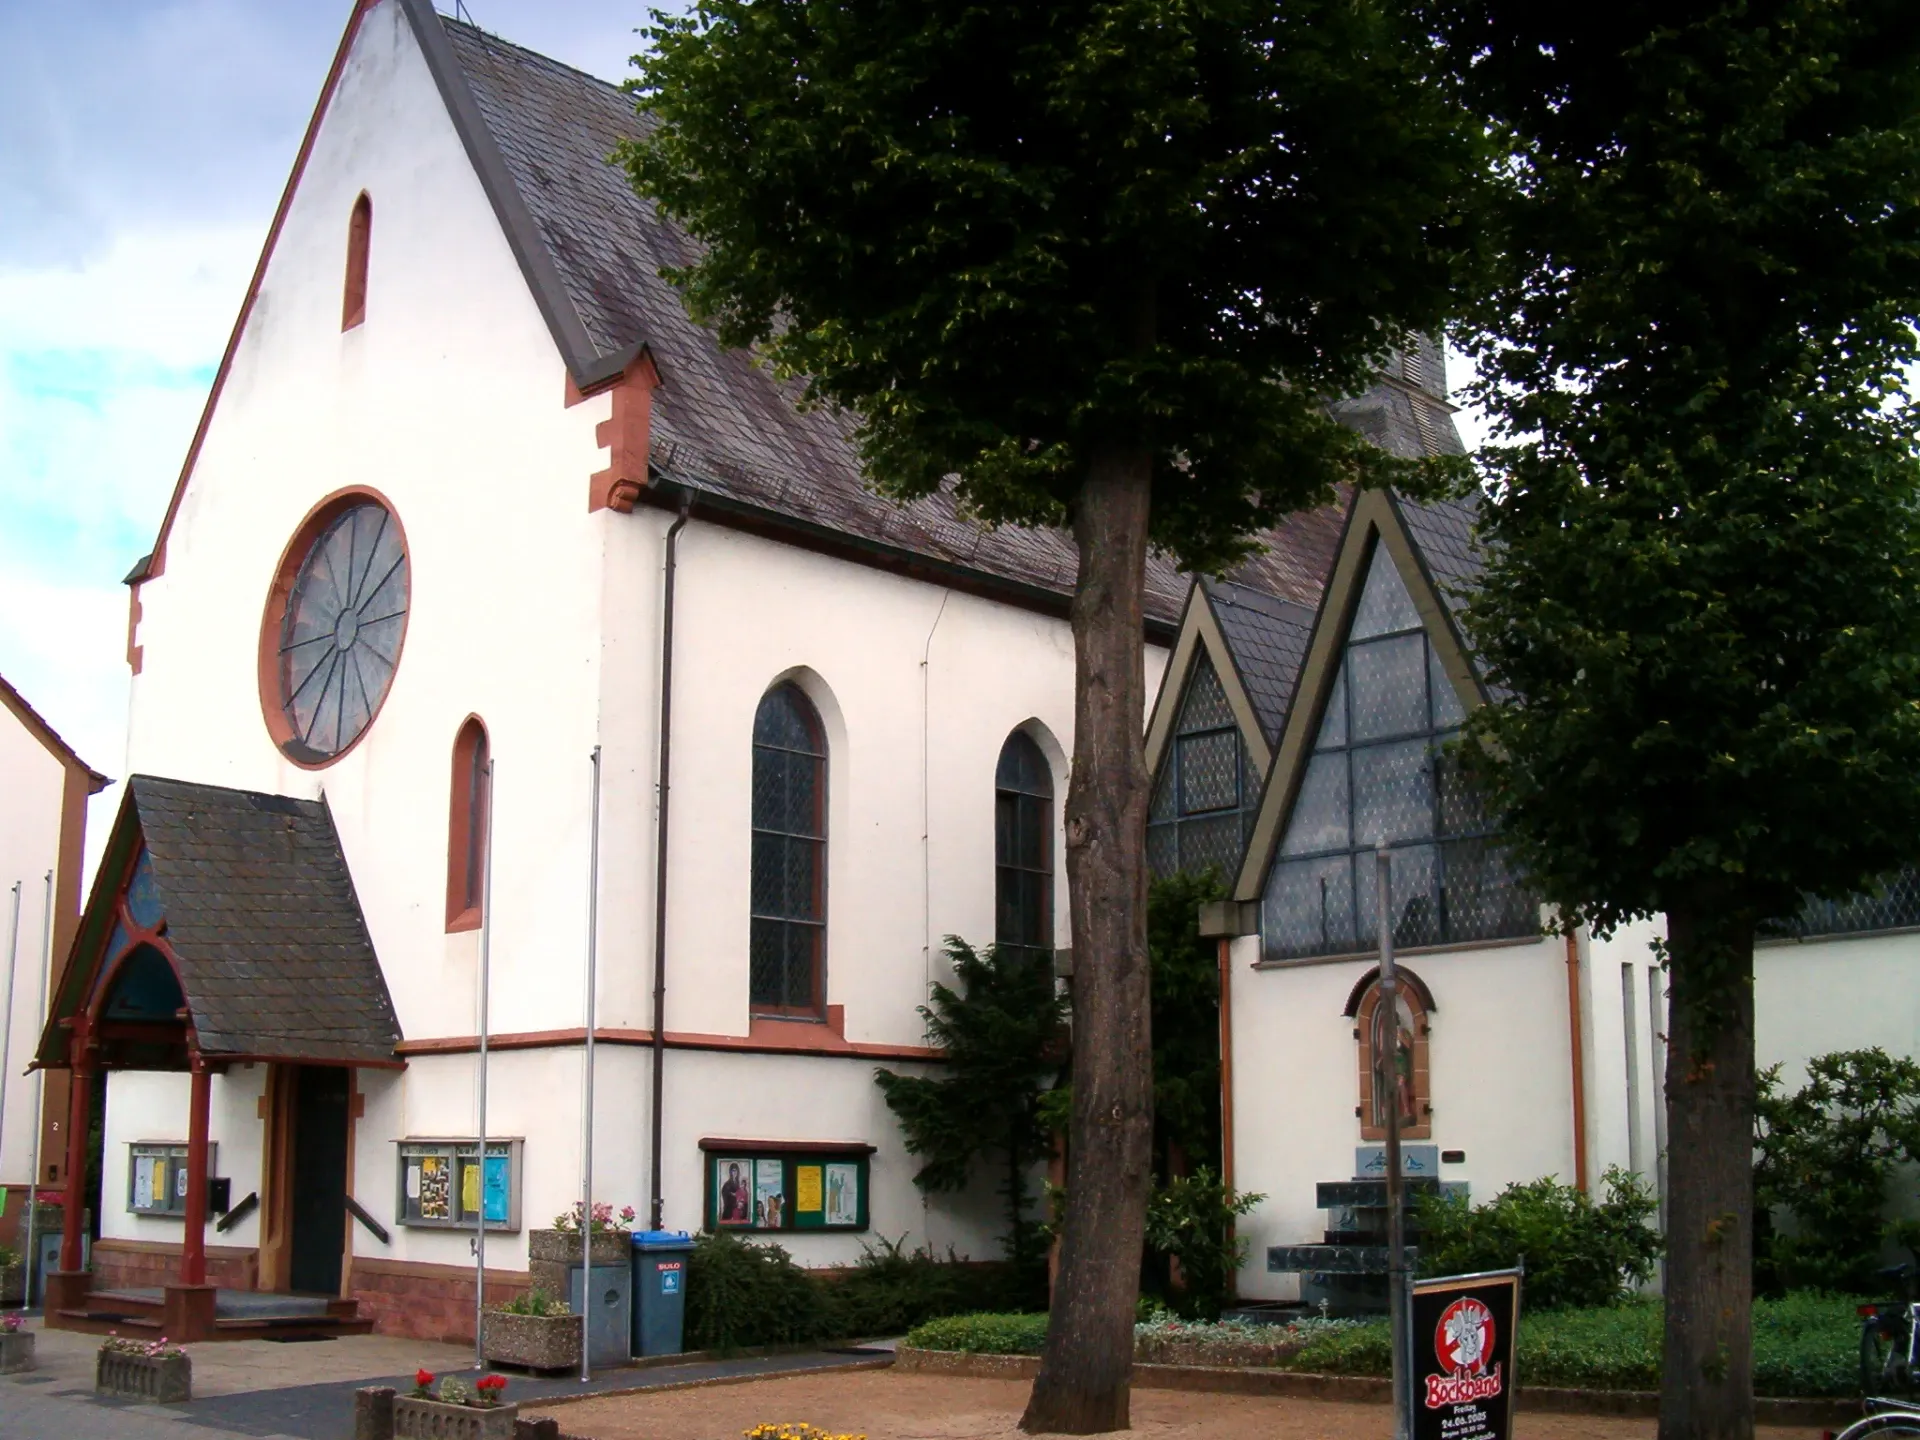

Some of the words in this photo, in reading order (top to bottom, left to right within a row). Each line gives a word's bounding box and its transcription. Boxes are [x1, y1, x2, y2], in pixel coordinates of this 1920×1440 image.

[53, 1121, 59, 1131] 2
[658, 1262, 681, 1270] SULO
[1425, 1362, 1501, 1408] Bockband
[1453, 1405, 1477, 1414] Freitag
